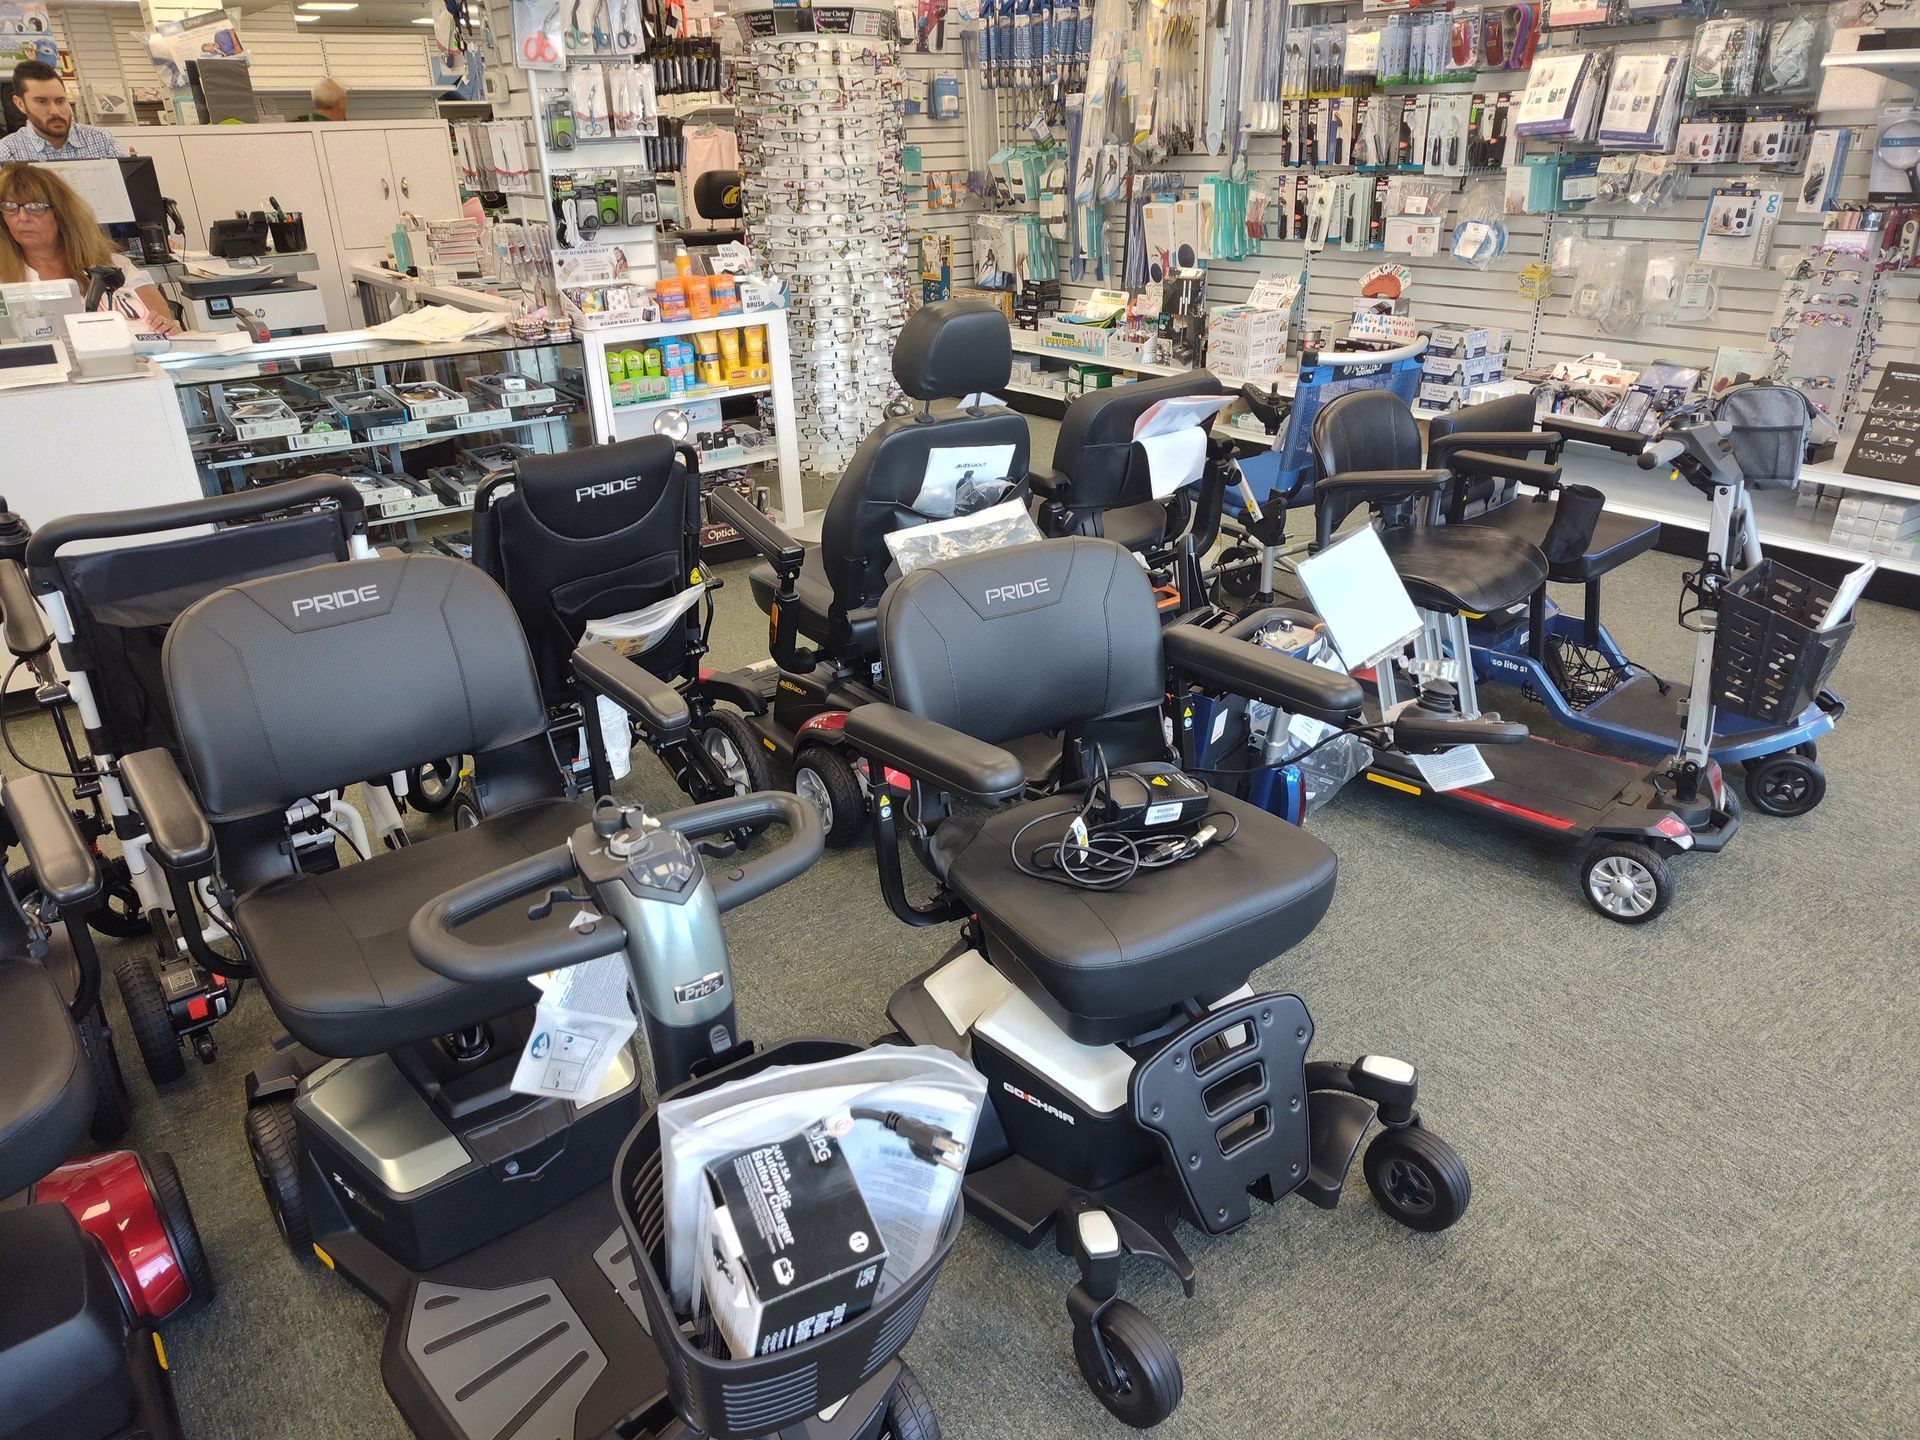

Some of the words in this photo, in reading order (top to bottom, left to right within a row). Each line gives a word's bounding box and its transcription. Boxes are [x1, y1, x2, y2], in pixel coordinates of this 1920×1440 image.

[832, 9, 850, 17] Choice
[746, 301, 765, 309] BRUSH
[576, 476, 638, 502] PRIDE
[292, 584, 380, 617] PRIDE
[985, 577, 1050, 605] PRIDE
[1503, 659, 1519, 671] lite
[761, 1147, 792, 1210] Automatic
[751, 1150, 775, 1195] Battery
[768, 1194, 795, 1245] Charger
